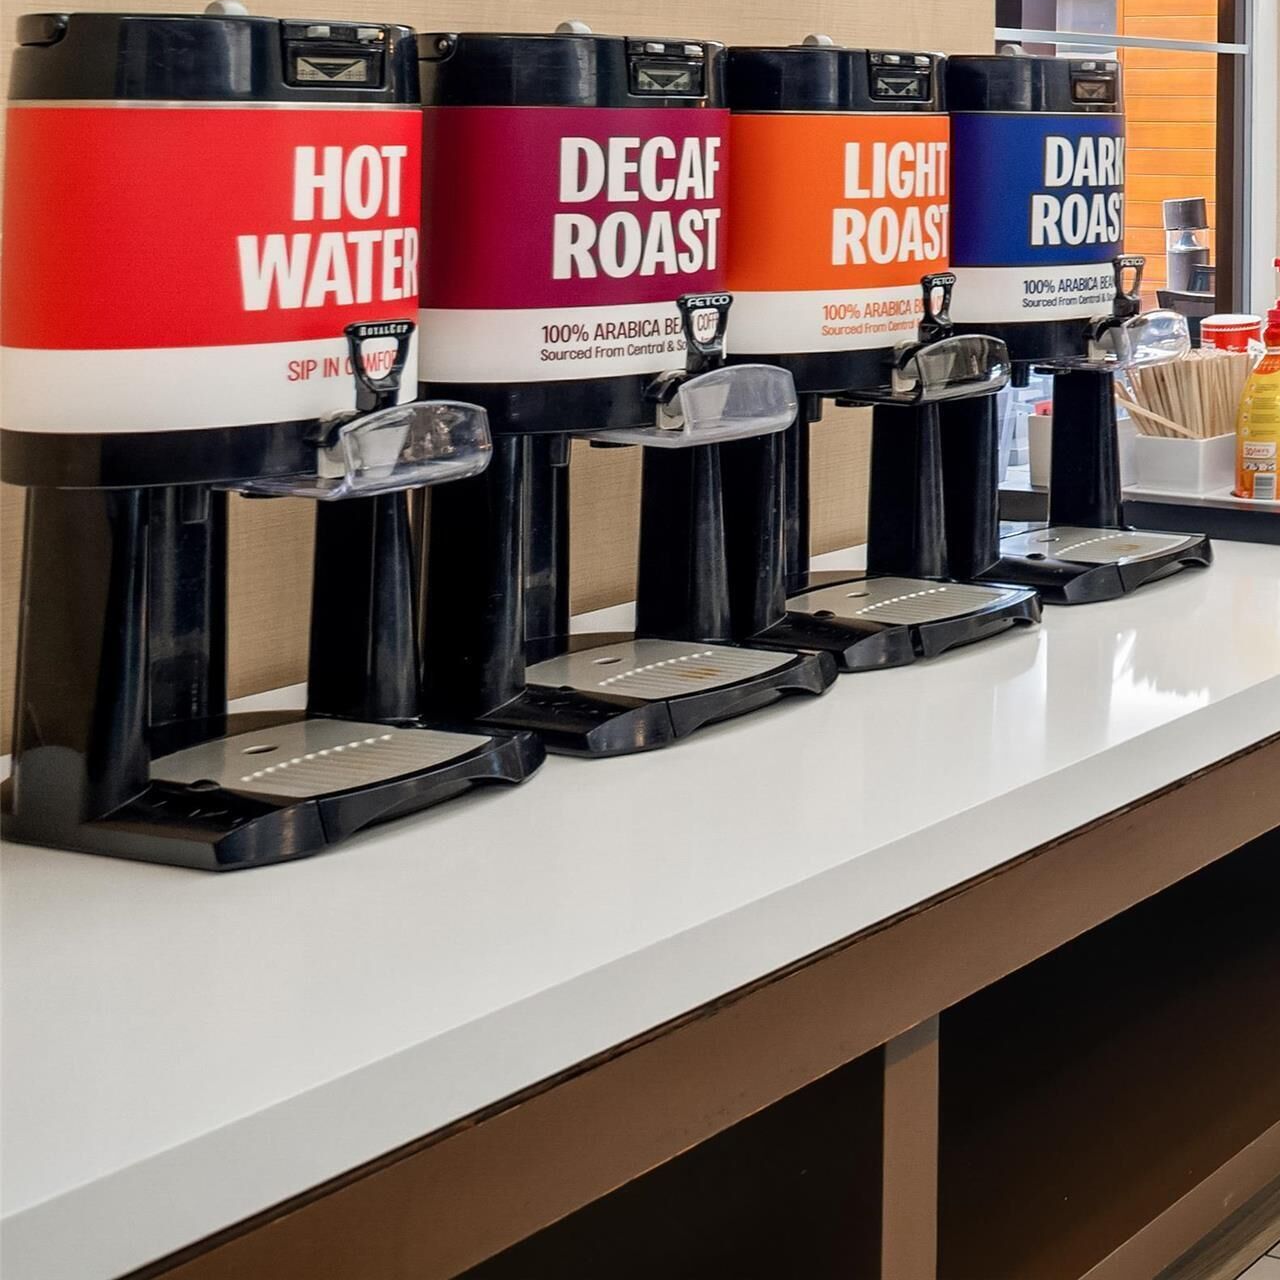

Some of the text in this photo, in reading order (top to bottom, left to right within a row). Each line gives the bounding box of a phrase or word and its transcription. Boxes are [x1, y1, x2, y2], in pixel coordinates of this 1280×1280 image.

[559, 136, 721, 203] DECAF
[844, 141, 948, 199] LIGHT
[1044, 136, 1125, 187] DARK
[293, 144, 408, 221] HOT
[832, 203, 949, 265] ROAST
[1031, 192, 1124, 246] ROAST
[552, 208, 721, 280] ROAST
[237, 227, 419, 311] WATER
[1023, 279, 1055, 294] 100%
[1057, 277, 1097, 293] ARABICA
[687, 296, 730, 308] FETCO
[822, 304, 861, 321] 100%
[863, 299, 912, 318] ARABICA
[1022, 297, 1057, 308] Sourced
[1059, 295, 1077, 306] From
[541, 324, 590, 344] 100%
[593, 319, 661, 341] ARABICA
[821, 324, 862, 336] Sourced
[864, 322, 887, 333] From
[287, 359, 318, 381] SIP
[323, 357, 340, 378] IN
[540, 347, 592, 362] Sourced
[595, 344, 625, 358] From
[627, 340, 665, 356] Central
[667, 341, 675, 353] &
